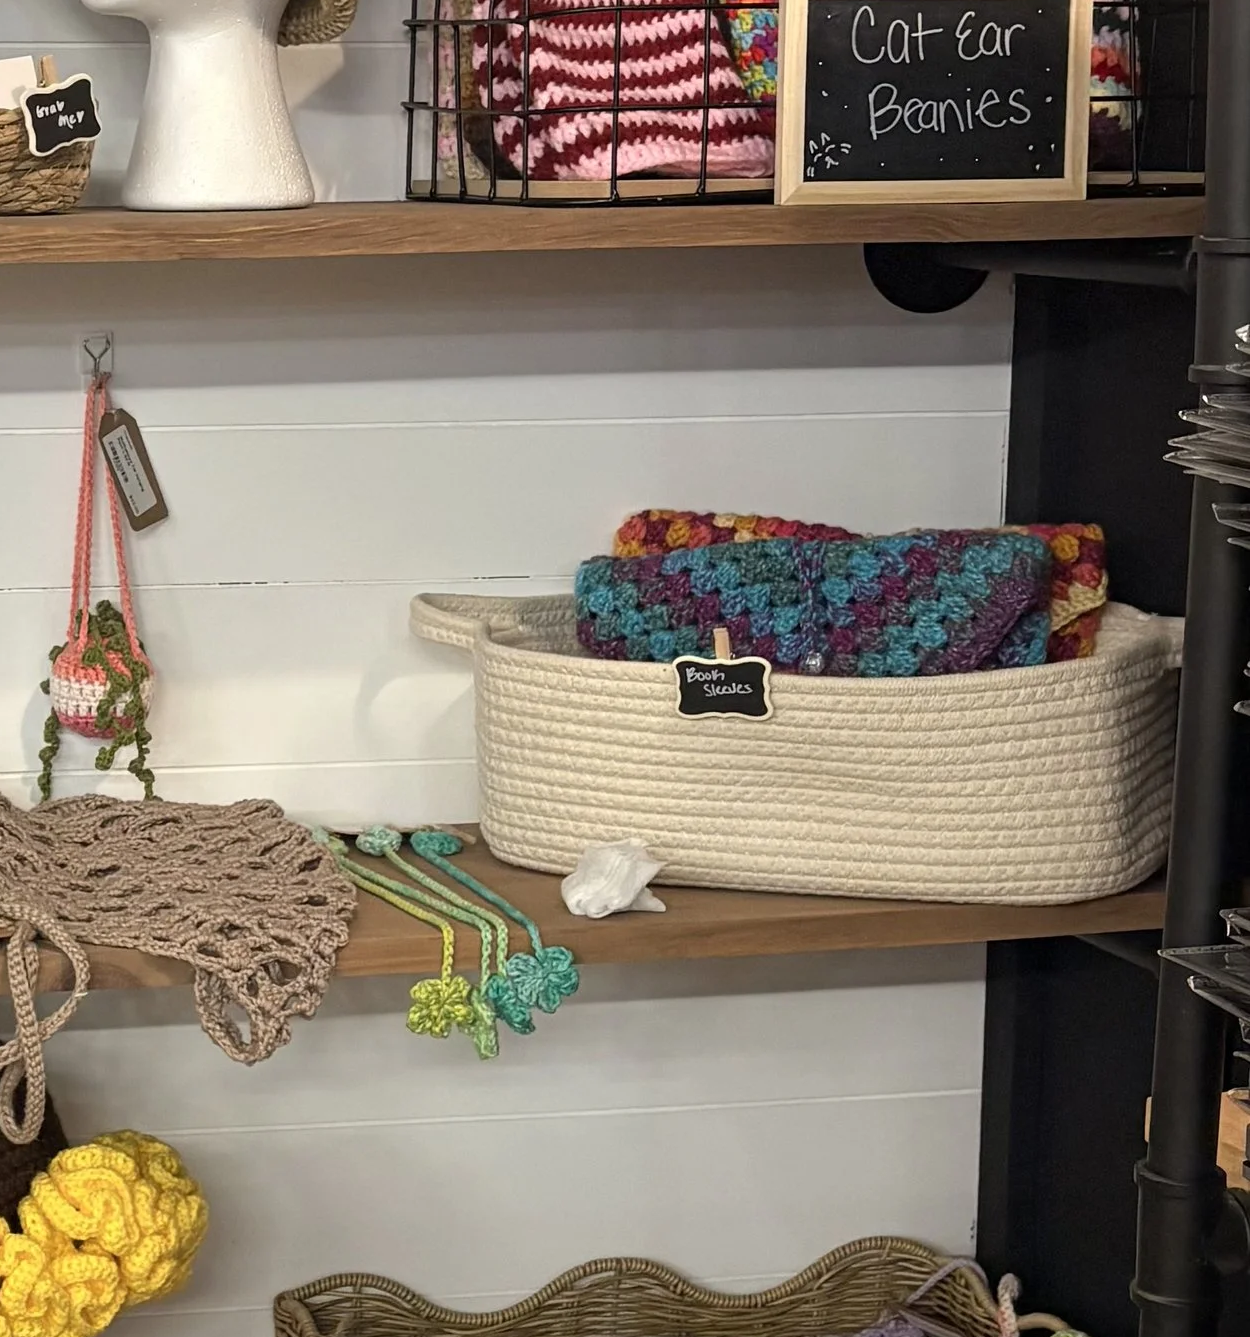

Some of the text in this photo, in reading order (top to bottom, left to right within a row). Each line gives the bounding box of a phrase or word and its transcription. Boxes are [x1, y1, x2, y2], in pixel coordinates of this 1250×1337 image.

[852, 6, 1025, 63] Cat Ear
[869, 84, 1031, 139] Beanies
